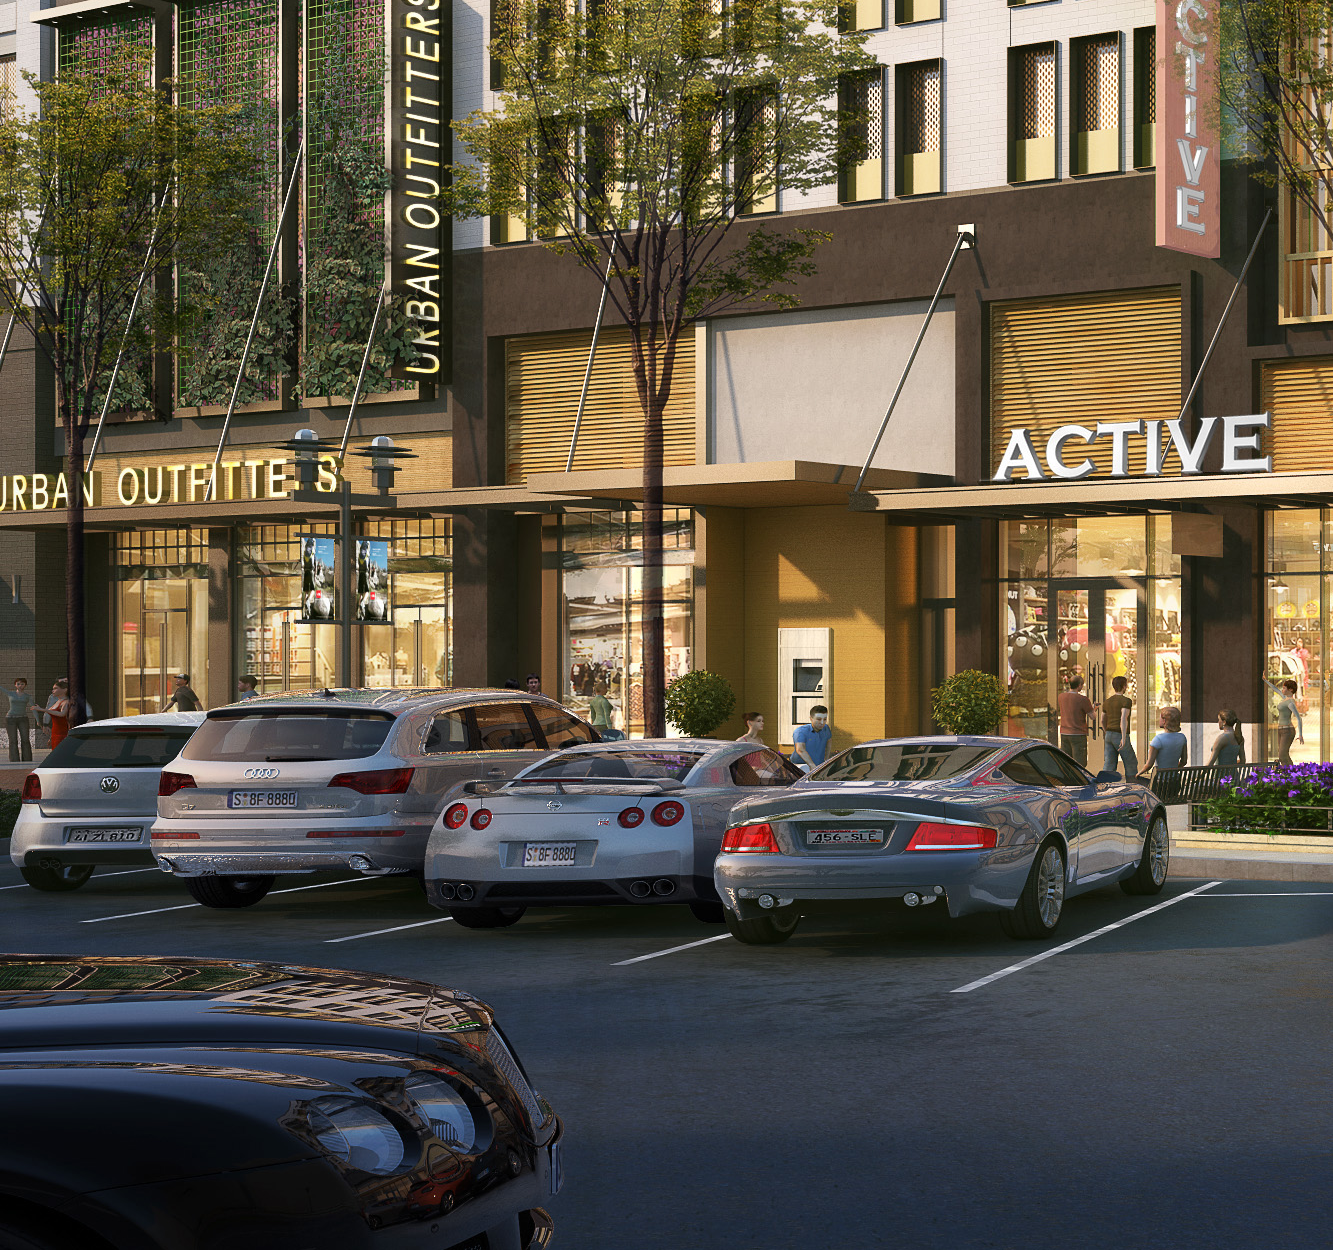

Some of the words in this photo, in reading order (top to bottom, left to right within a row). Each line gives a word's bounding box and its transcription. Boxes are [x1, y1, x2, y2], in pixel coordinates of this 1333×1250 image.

[404, 243, 441, 375] URBAN
[117, 454, 344, 506] OUTFITTES
[992, 410, 1273, 481] ACTIVE
